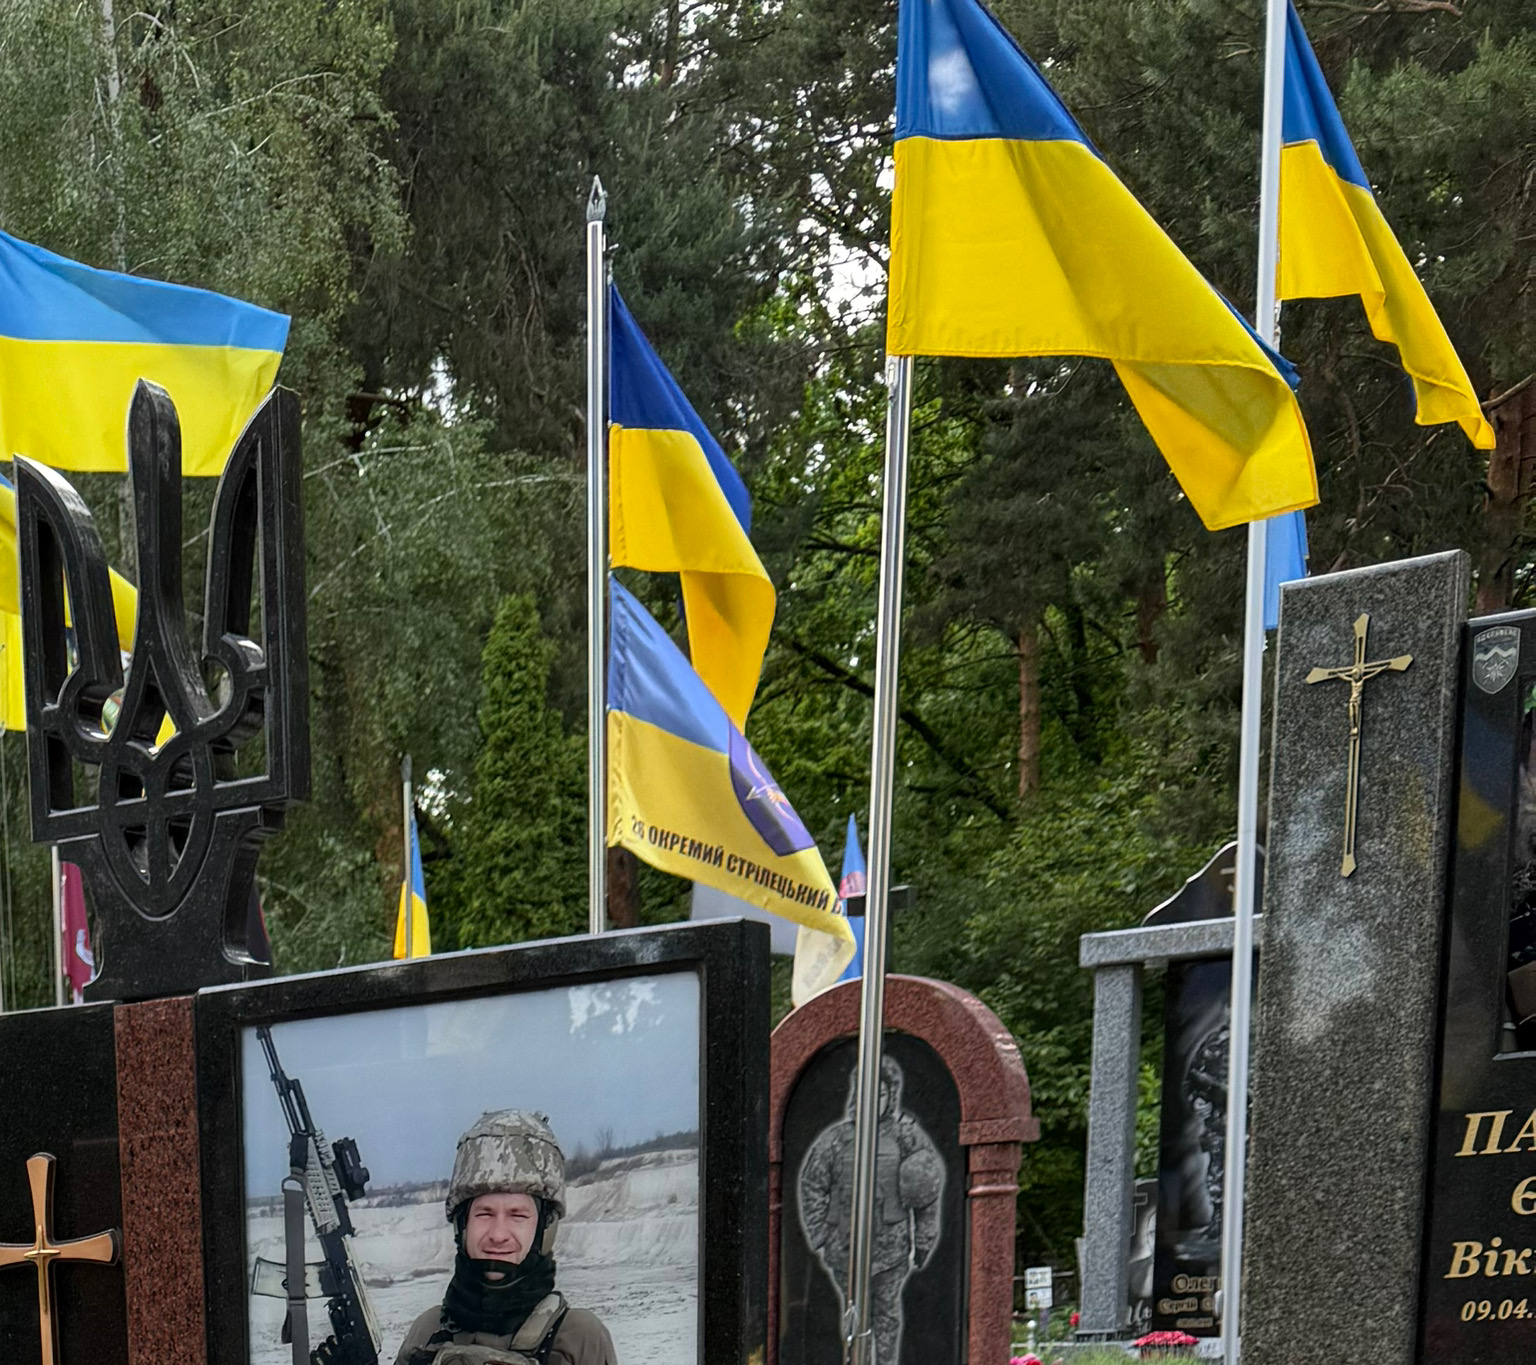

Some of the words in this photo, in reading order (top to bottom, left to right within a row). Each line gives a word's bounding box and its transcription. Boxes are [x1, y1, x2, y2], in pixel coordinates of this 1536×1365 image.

[648, 825, 725, 868] ОКРЕМИЙ
[725, 853, 831, 911] СТРІЛЕЦЬКИЙ
[1454, 1109, 1536, 1158] ПА
[1443, 1236, 1536, 1281] Вік
[1460, 1298, 1536, 1323] 09.04.
